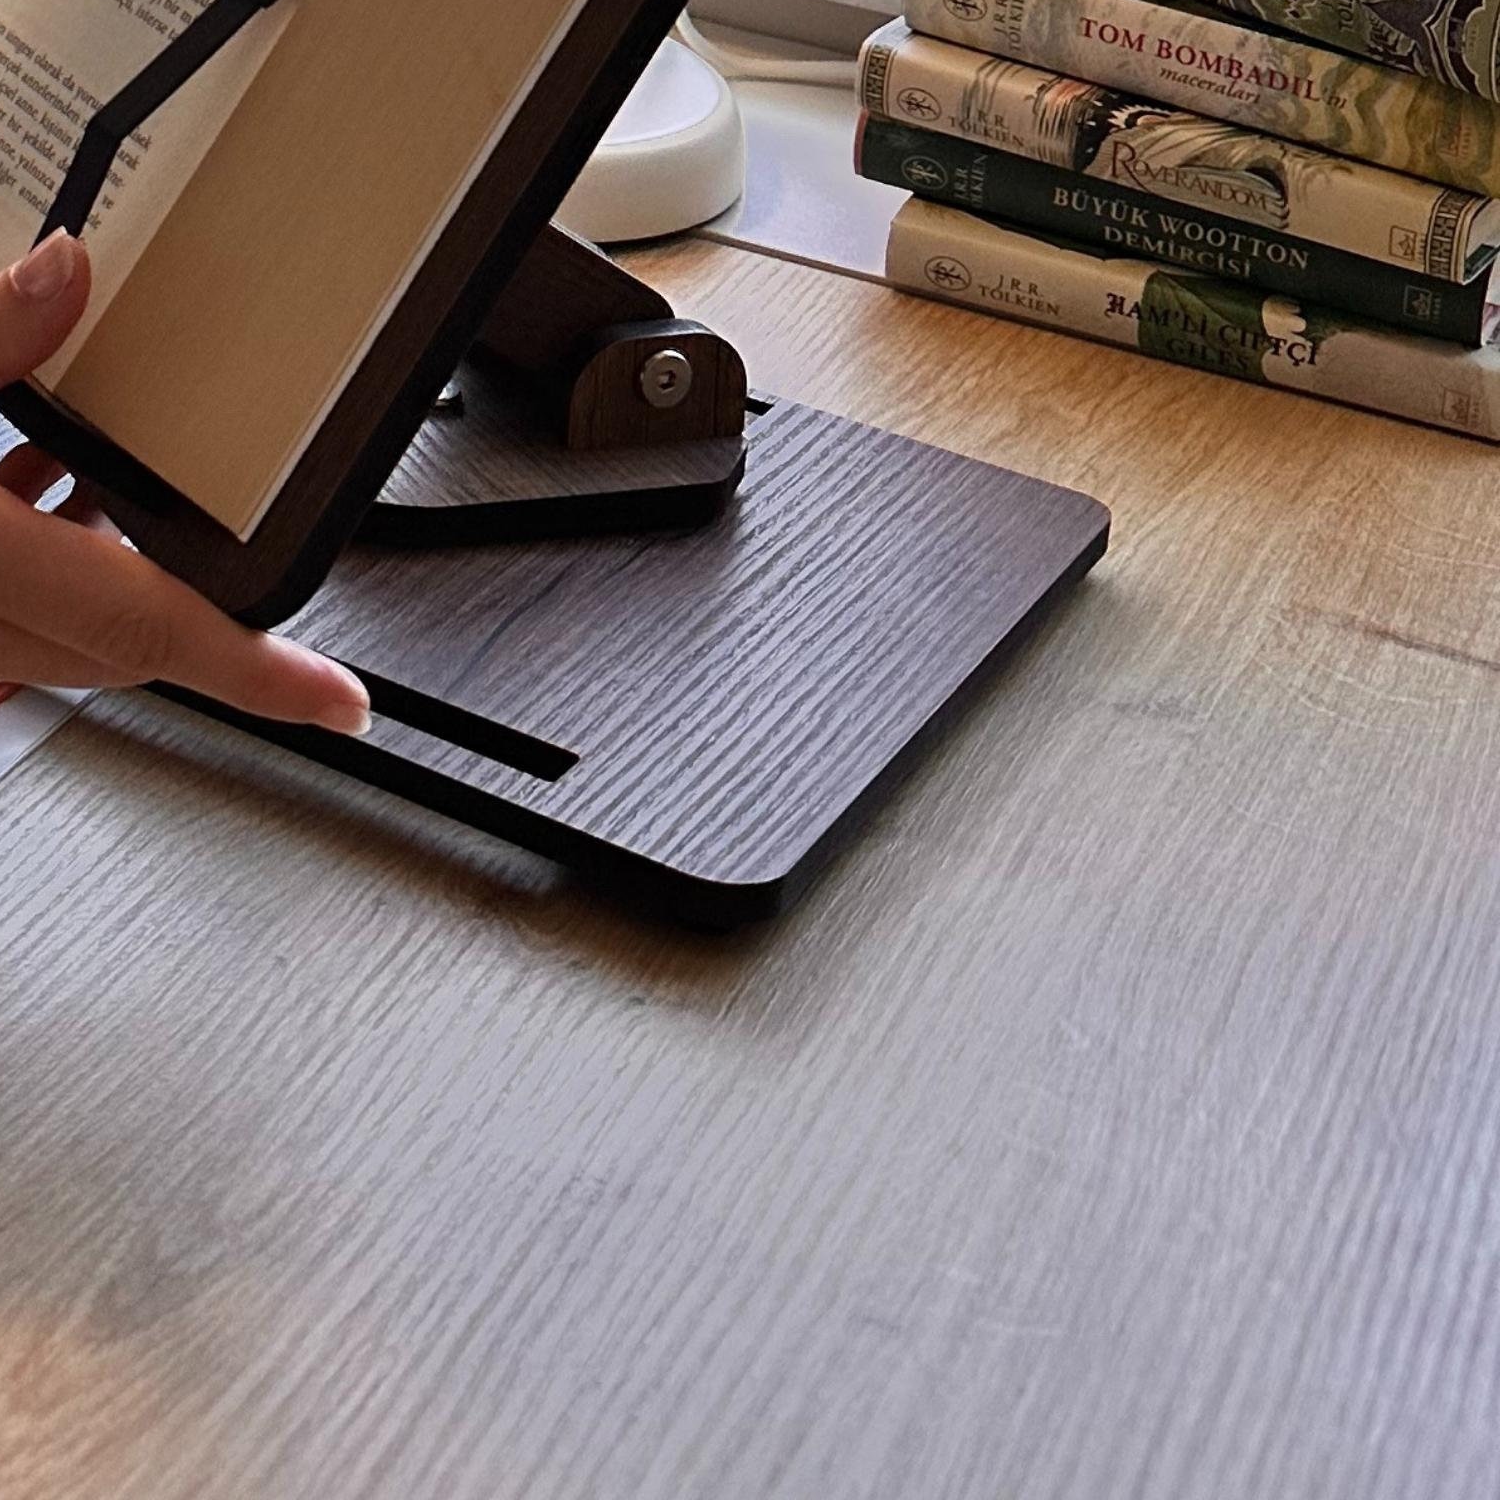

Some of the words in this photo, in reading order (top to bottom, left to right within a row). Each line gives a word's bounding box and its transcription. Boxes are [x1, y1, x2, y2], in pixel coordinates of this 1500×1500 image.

[1079, 16, 1147, 53] TOM
[948, 116, 1025, 148] TOLKIEN
[1054, 186, 1150, 228] BÜYÜK
[1157, 213, 1309, 271] WOOTTON
[1103, 226, 1252, 278] DEMİRCİSİ
[978, 284, 1061, 317] TOLKIEN
